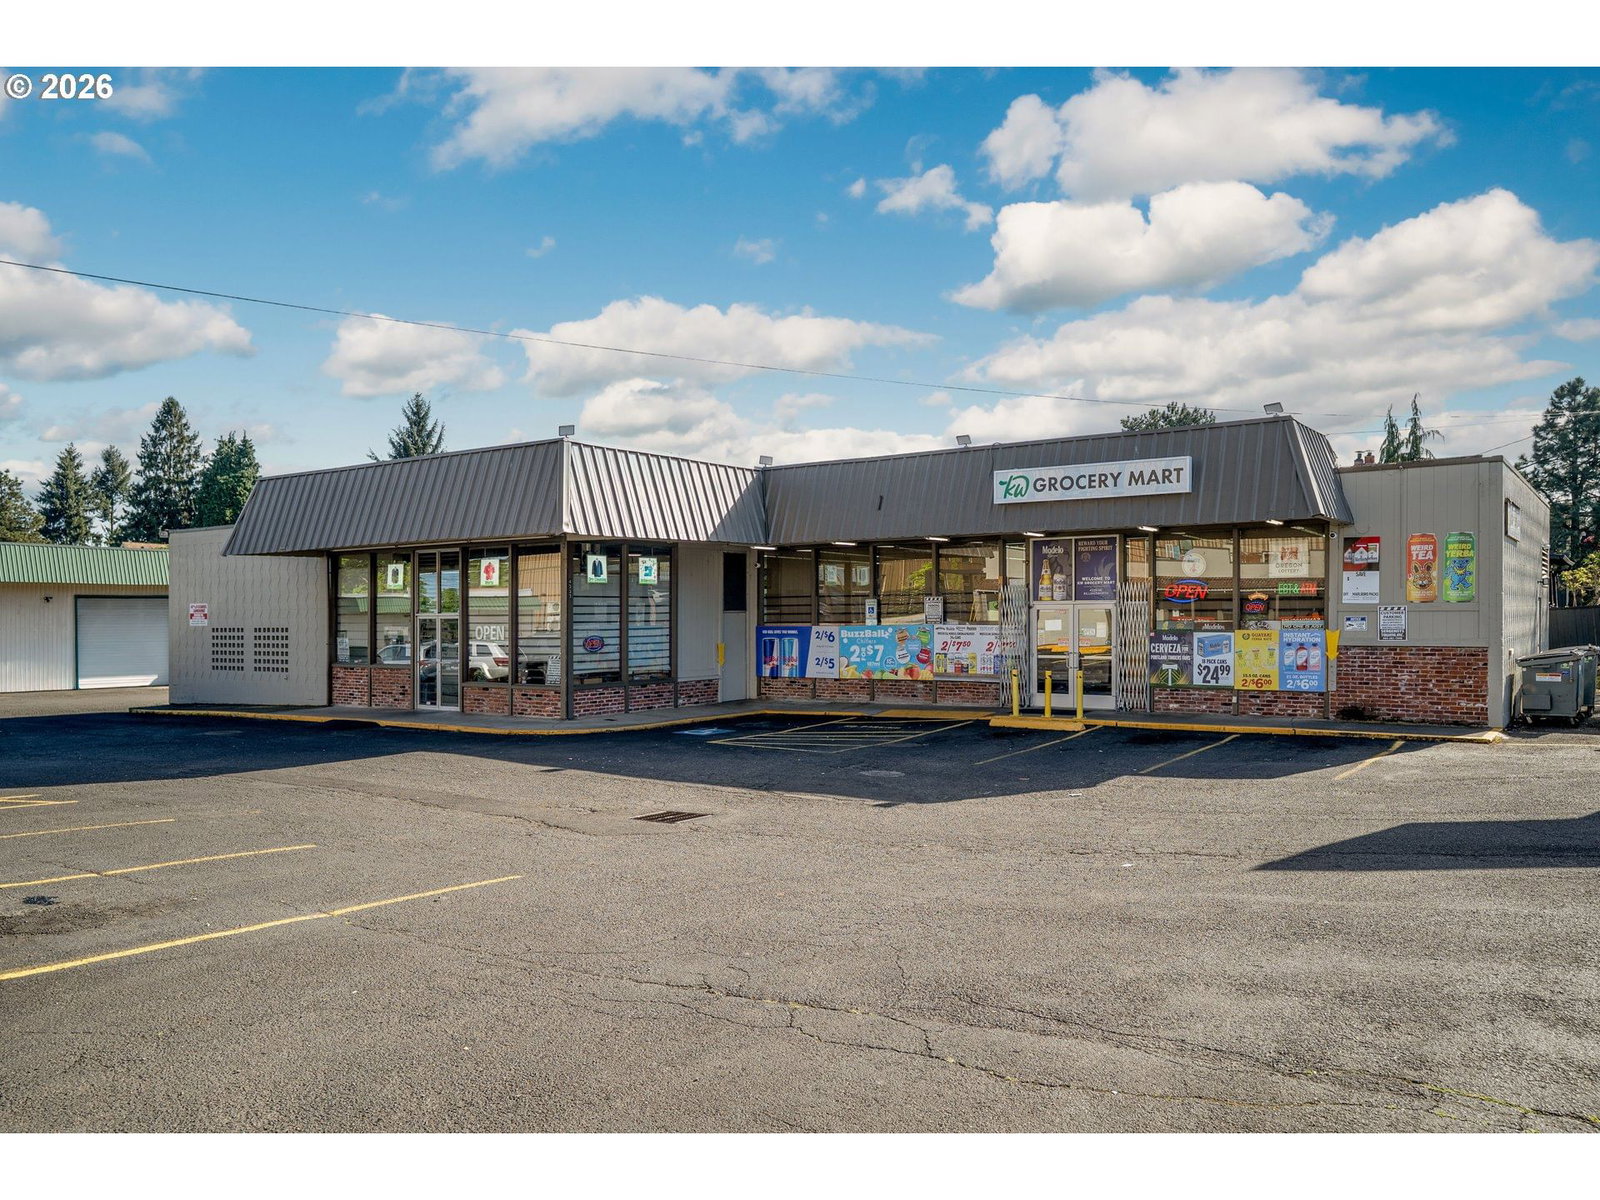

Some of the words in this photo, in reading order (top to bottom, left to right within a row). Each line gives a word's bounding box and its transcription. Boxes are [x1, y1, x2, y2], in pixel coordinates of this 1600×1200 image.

[1033, 471, 1123, 493] GROCERY
[1128, 467, 1184, 487] MART
[1042, 545, 1064, 554] Modelo
[1411, 550, 1434, 560] TEA
[1446, 549, 1474, 558] YERBA
[1164, 583, 1209, 600] OPEN
[1278, 583, 1292, 595] EBT
[1244, 603, 1265, 611] OPEN
[474, 625, 505, 641] OPEN
[815, 630, 835, 643] 2/$6
[849, 644, 861, 662] 2
[1150, 643, 1182, 653] CERVEZA
[815, 656, 835, 669] 2/$5
